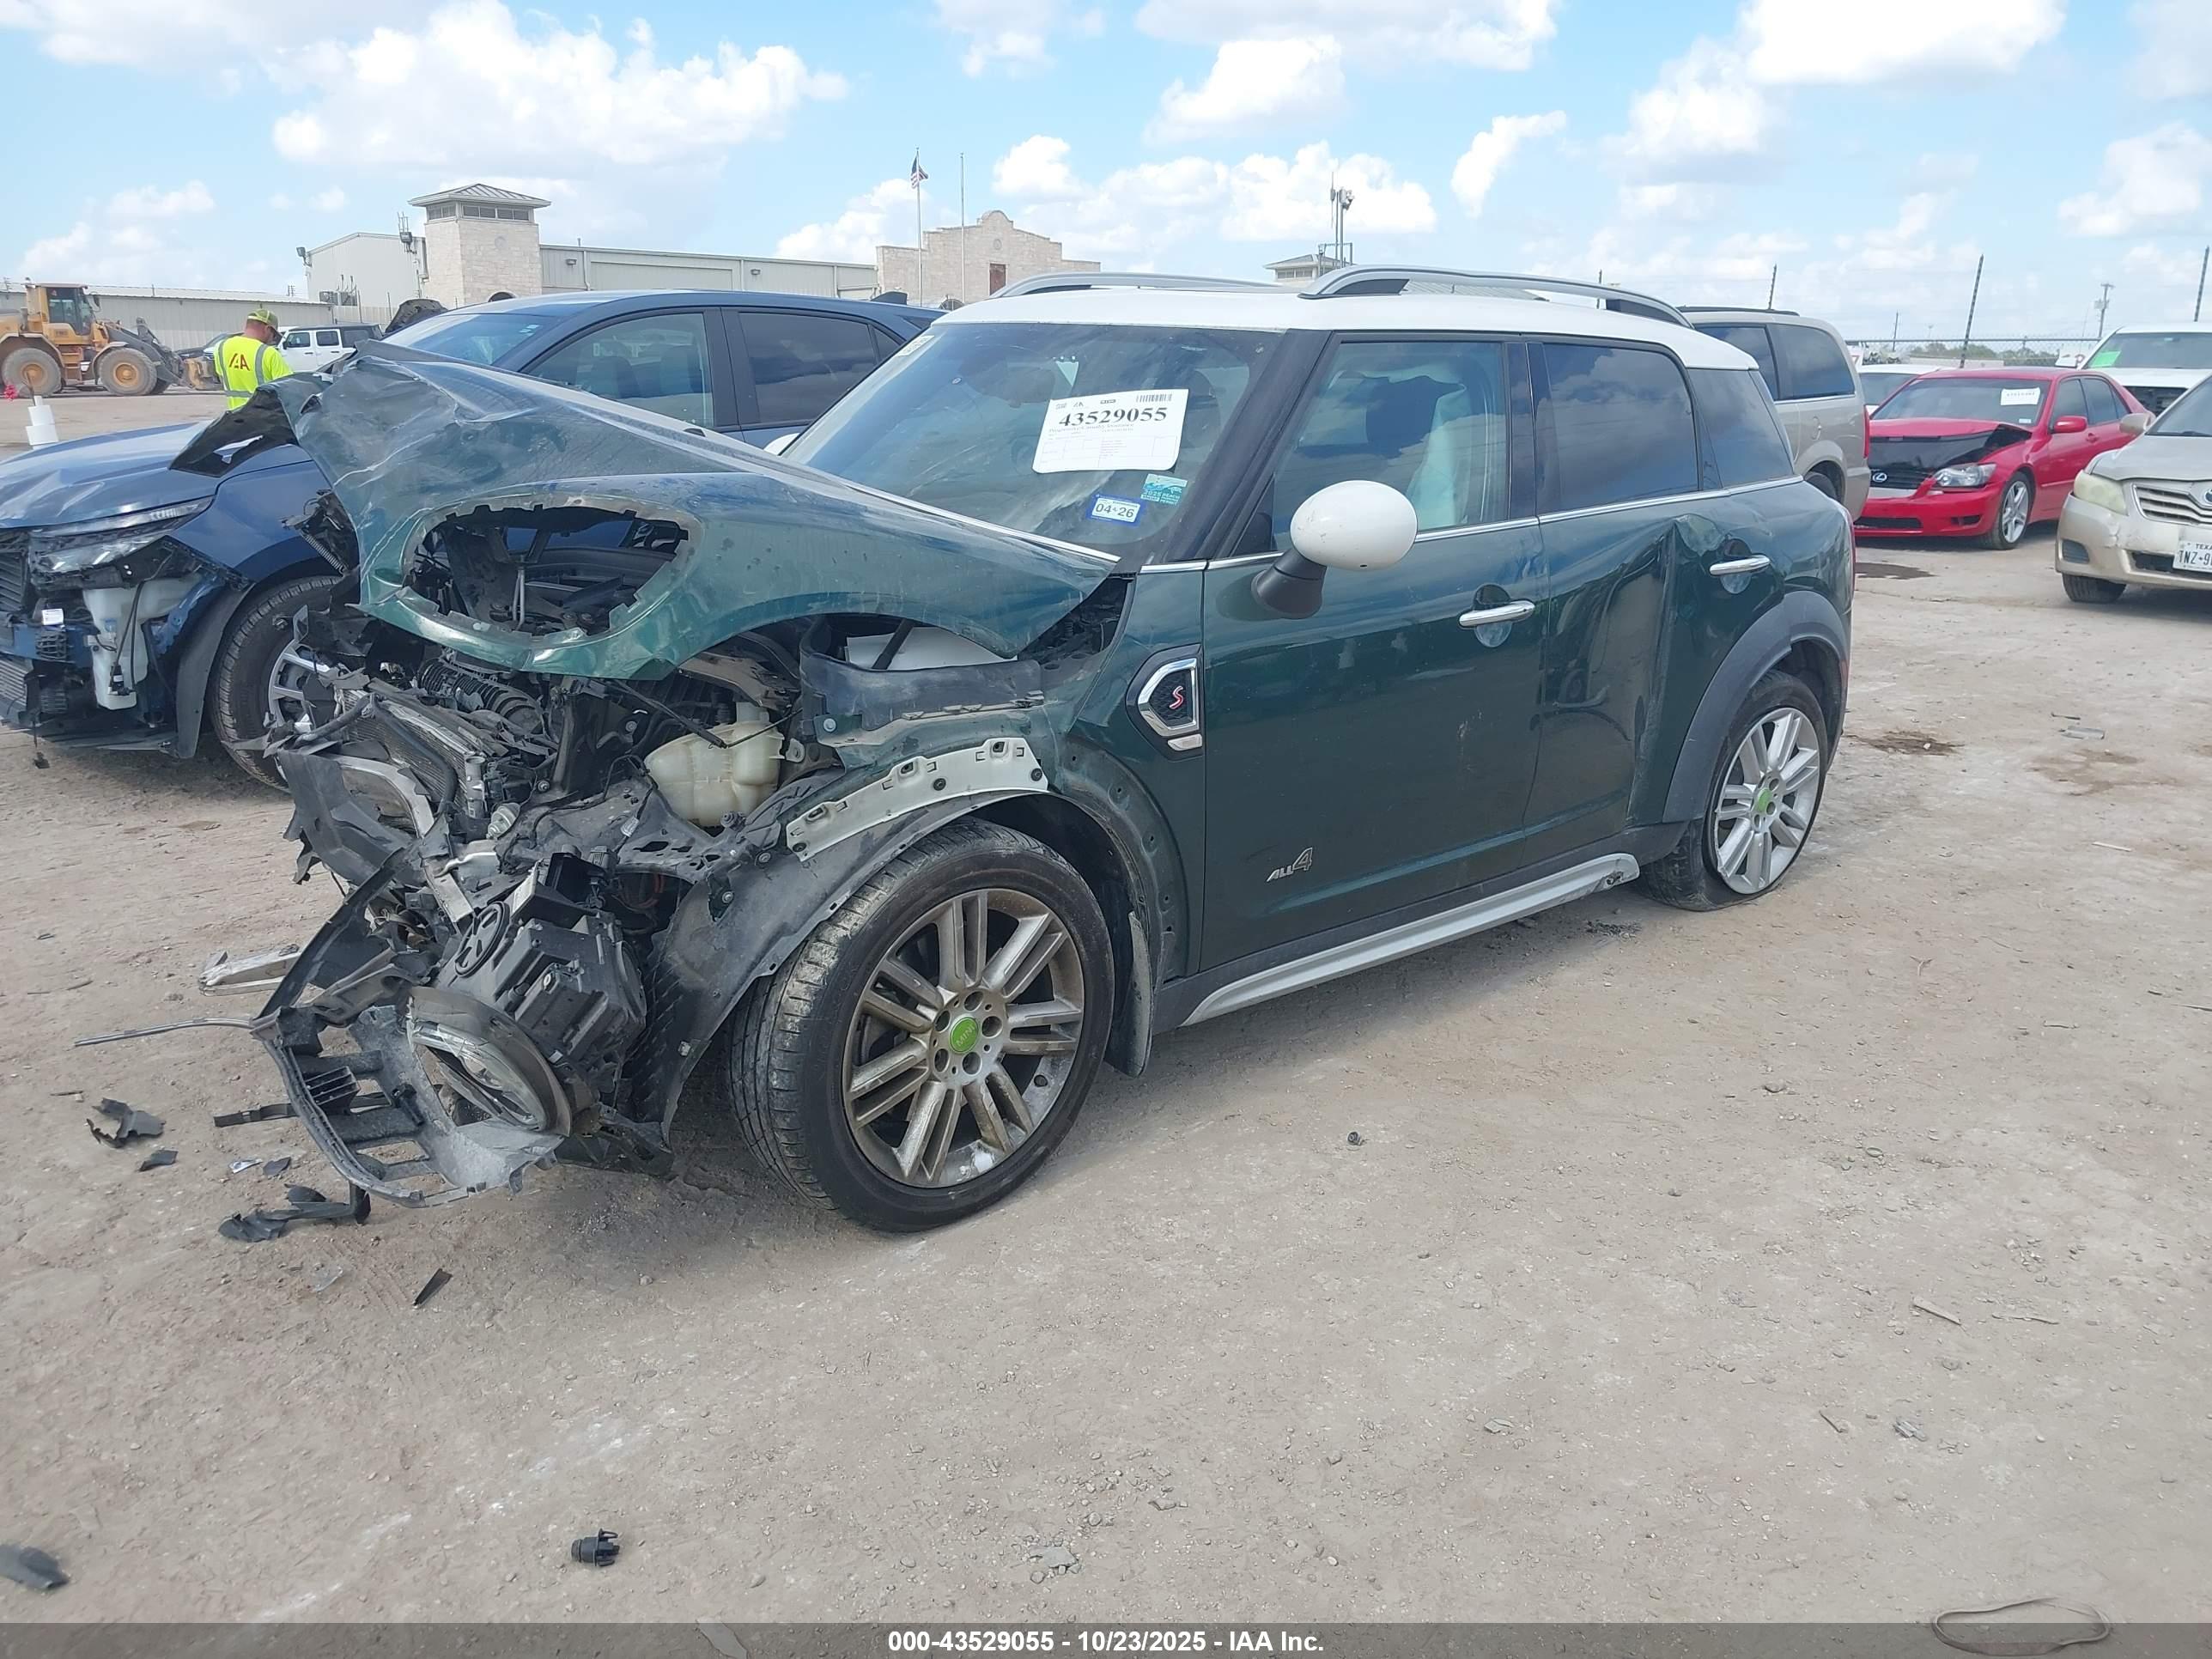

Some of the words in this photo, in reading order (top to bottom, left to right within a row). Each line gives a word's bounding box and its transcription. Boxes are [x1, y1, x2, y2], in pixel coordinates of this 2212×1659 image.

[1059, 407, 1168, 427] 43529055
[1169, 686, 1184, 709] S
[1266, 847, 1313, 883] ALL4
[956, 1024, 975, 1047] MINI
